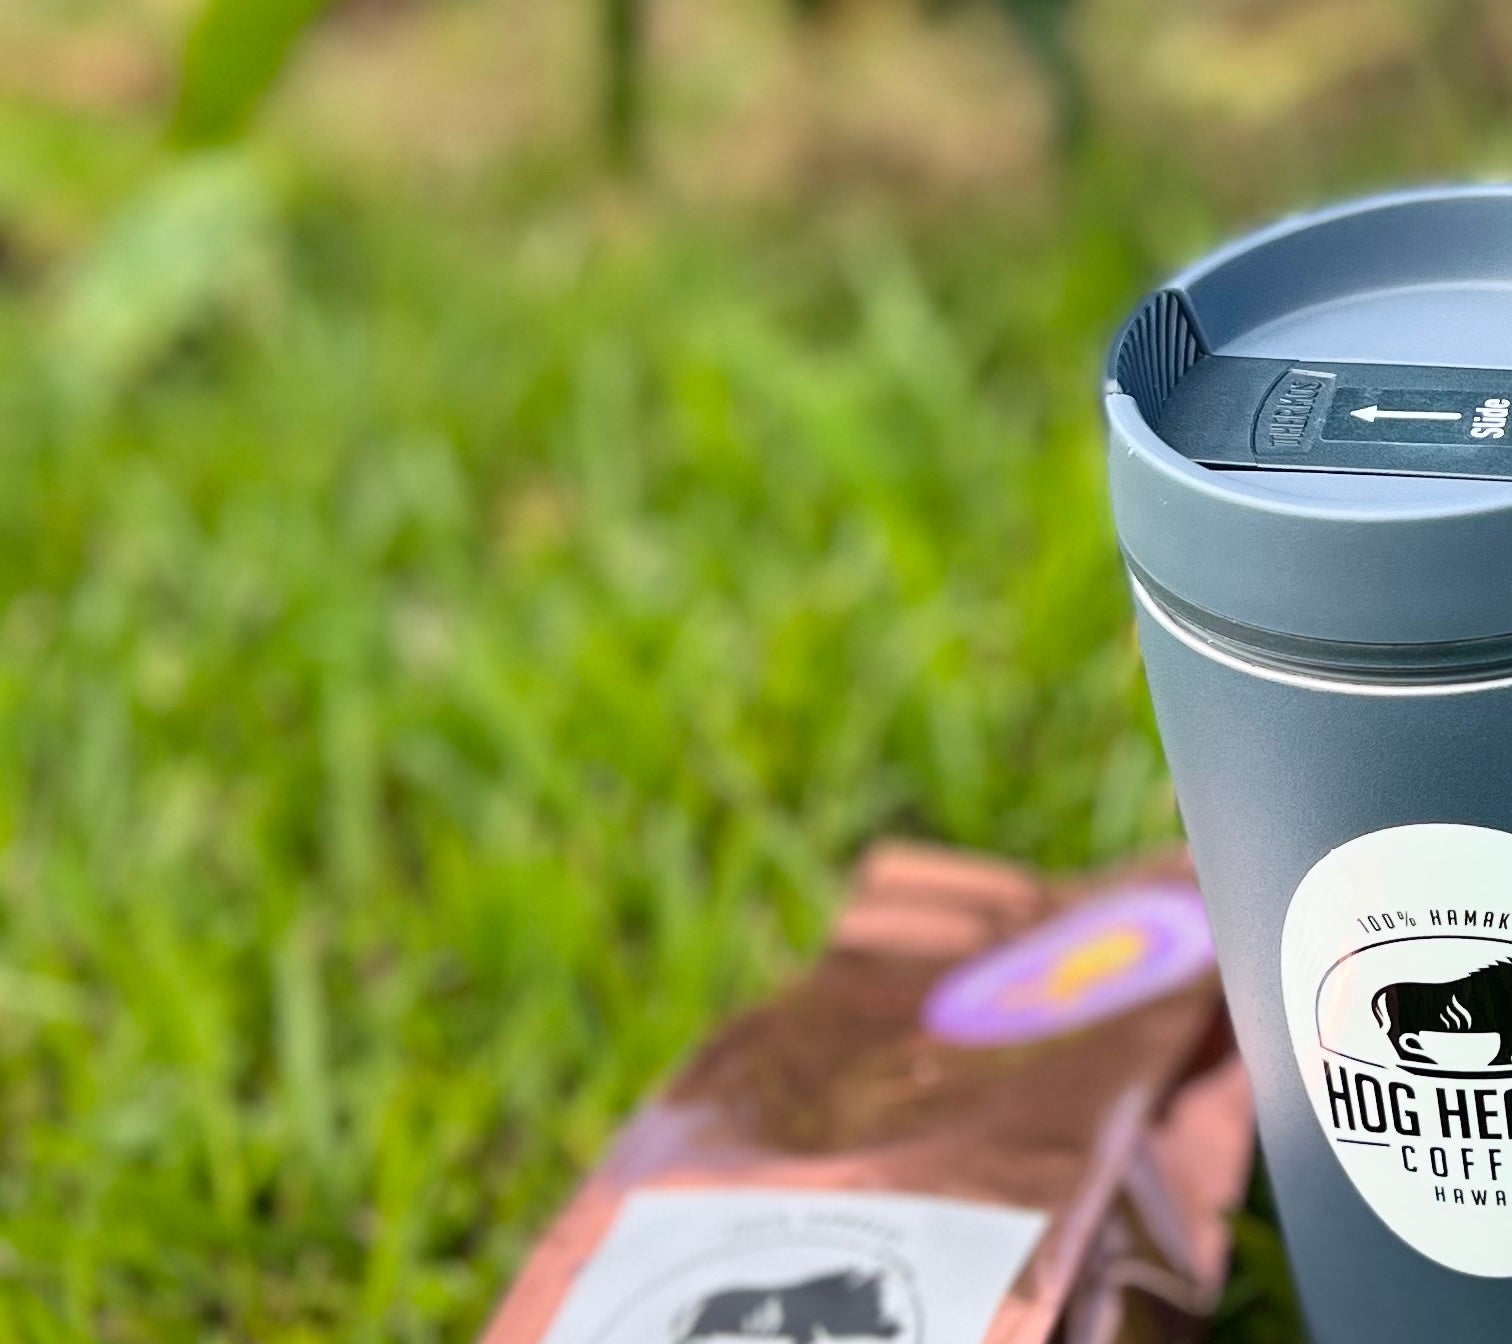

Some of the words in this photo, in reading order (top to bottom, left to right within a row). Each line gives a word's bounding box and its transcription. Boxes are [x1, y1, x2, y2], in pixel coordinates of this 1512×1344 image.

[1469, 398, 1511, 439] Slide
[1357, 909, 1416, 934] 100%
[1323, 1059, 1421, 1138] HOG
